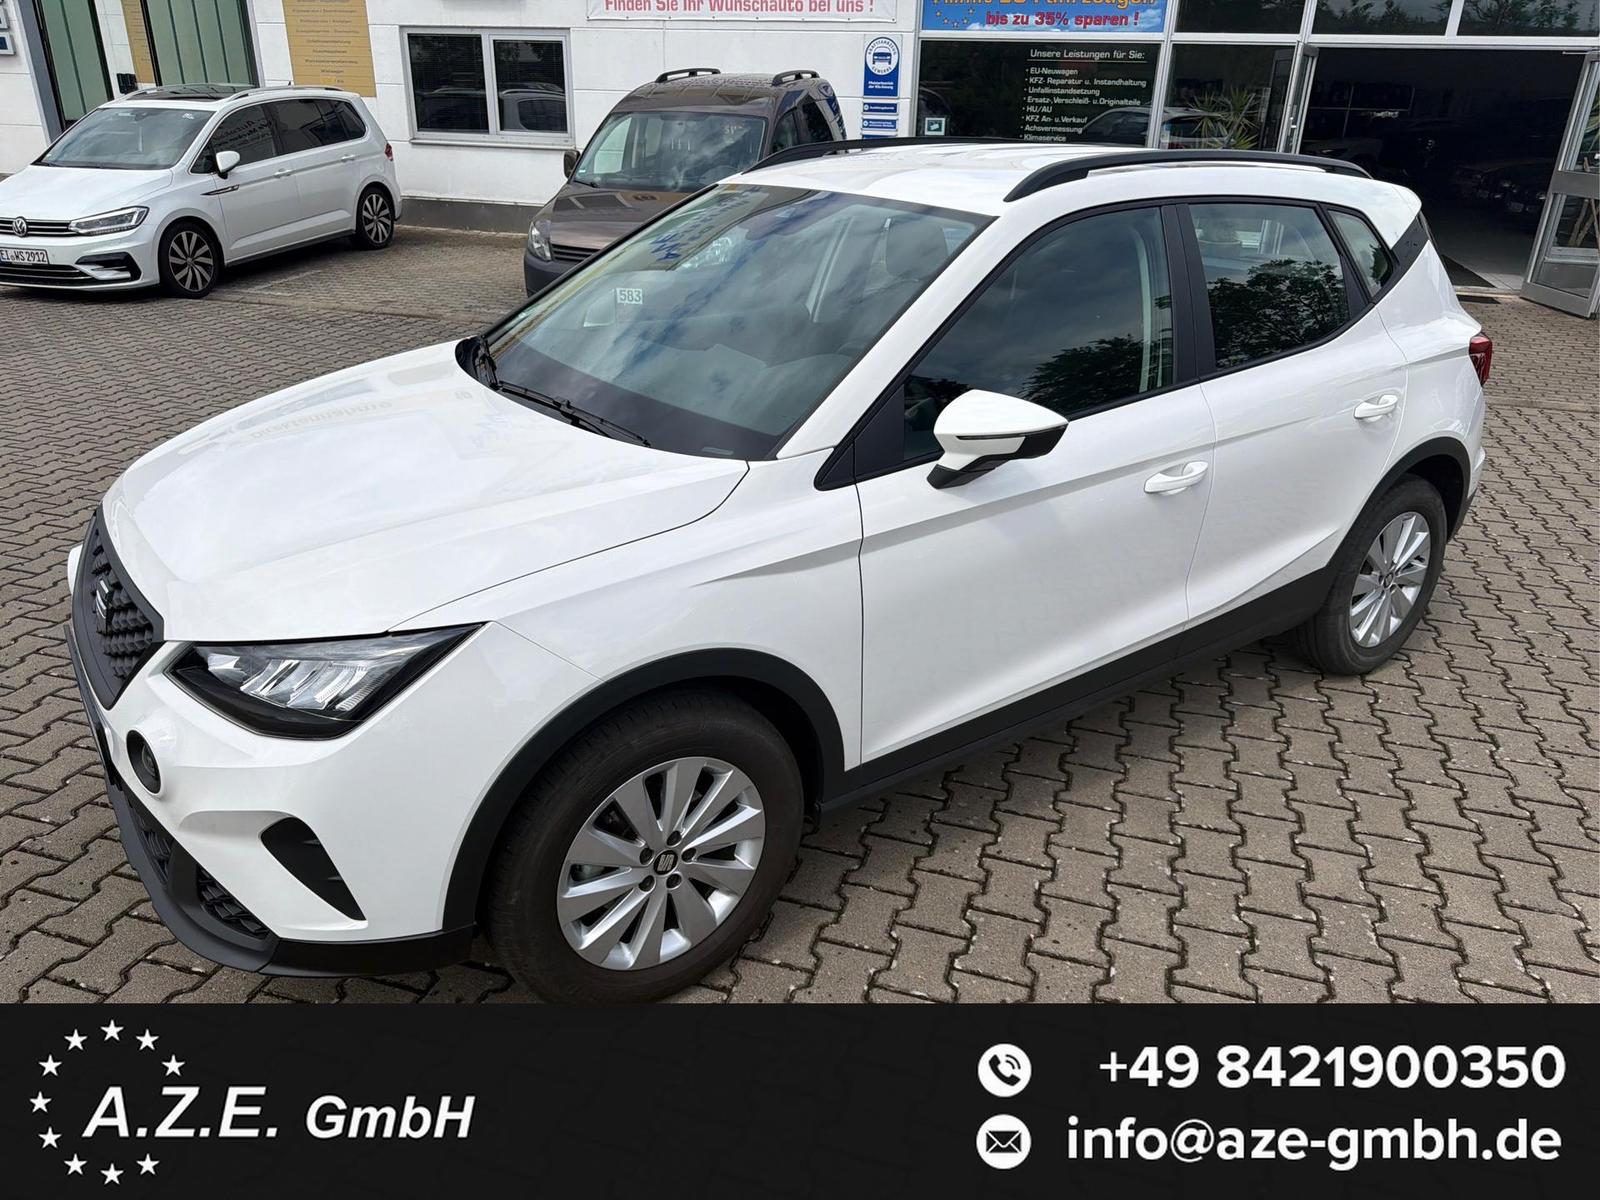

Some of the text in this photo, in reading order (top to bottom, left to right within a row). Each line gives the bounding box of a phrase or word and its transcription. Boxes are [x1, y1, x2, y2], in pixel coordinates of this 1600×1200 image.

[605, 0, 650, 10] Finden
[656, 0, 678, 11] Sie
[684, 0, 704, 11] Ihr
[709, 0, 803, 12] Wunschauto
[808, 0, 830, 12] bei
[836, 0, 863, 12] uns
[986, 12, 1008, 25] bis
[1012, 14, 1030, 25] zu
[1034, 12, 1068, 26] 35%
[1074, 14, 1128, 28] sparen
[1030, 49, 1145, 60] Unsere Leistungen für Sie:
[1030, 68, 1078, 76] EU-Neuwagen
[1094, 79, 1146, 88] Instandhaltung
[1028, 88, 1100, 96] Unfallinstandsetzung
[1024, 125, 1083, 134] Achsvermessung
[26, 251, 46, 262] 2912
[620, 290, 641, 302] 583
